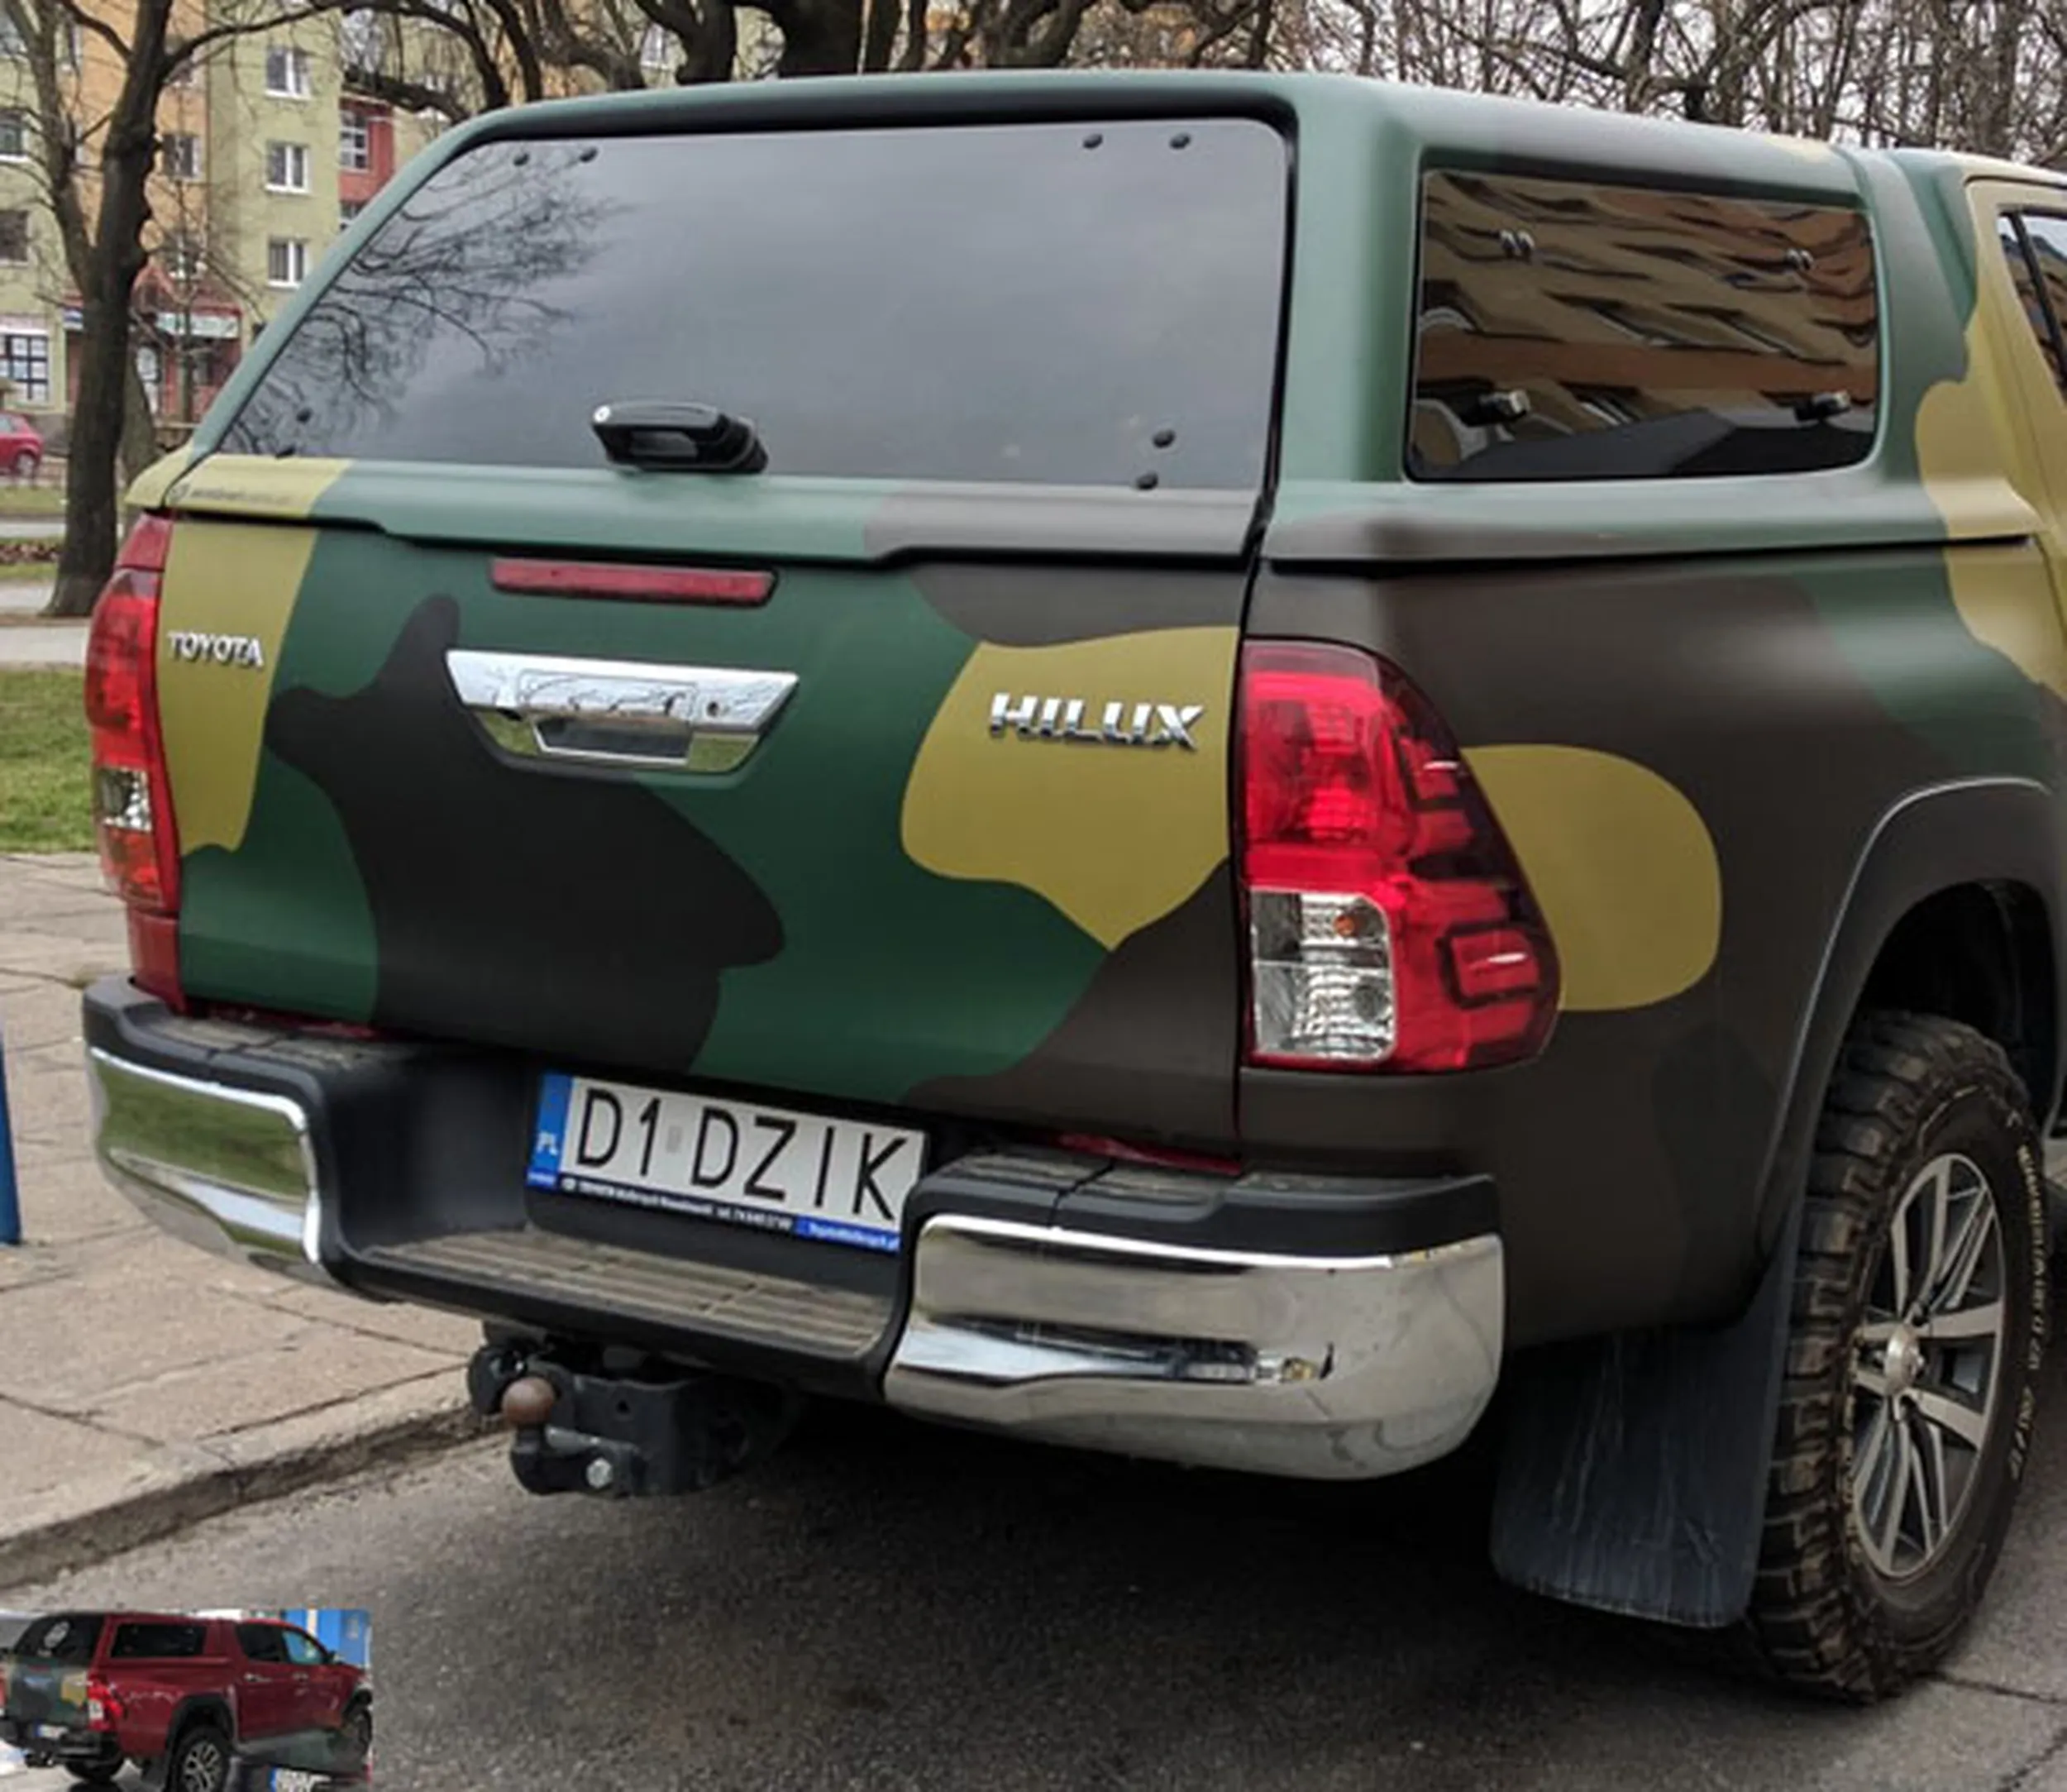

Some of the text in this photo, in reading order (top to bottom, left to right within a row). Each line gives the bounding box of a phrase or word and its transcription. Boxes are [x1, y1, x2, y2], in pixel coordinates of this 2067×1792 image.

[168, 631, 265, 668] TOYOTA
[989, 692, 1204, 752] HILUX
[578, 1088, 908, 1222] D1 DZIK
